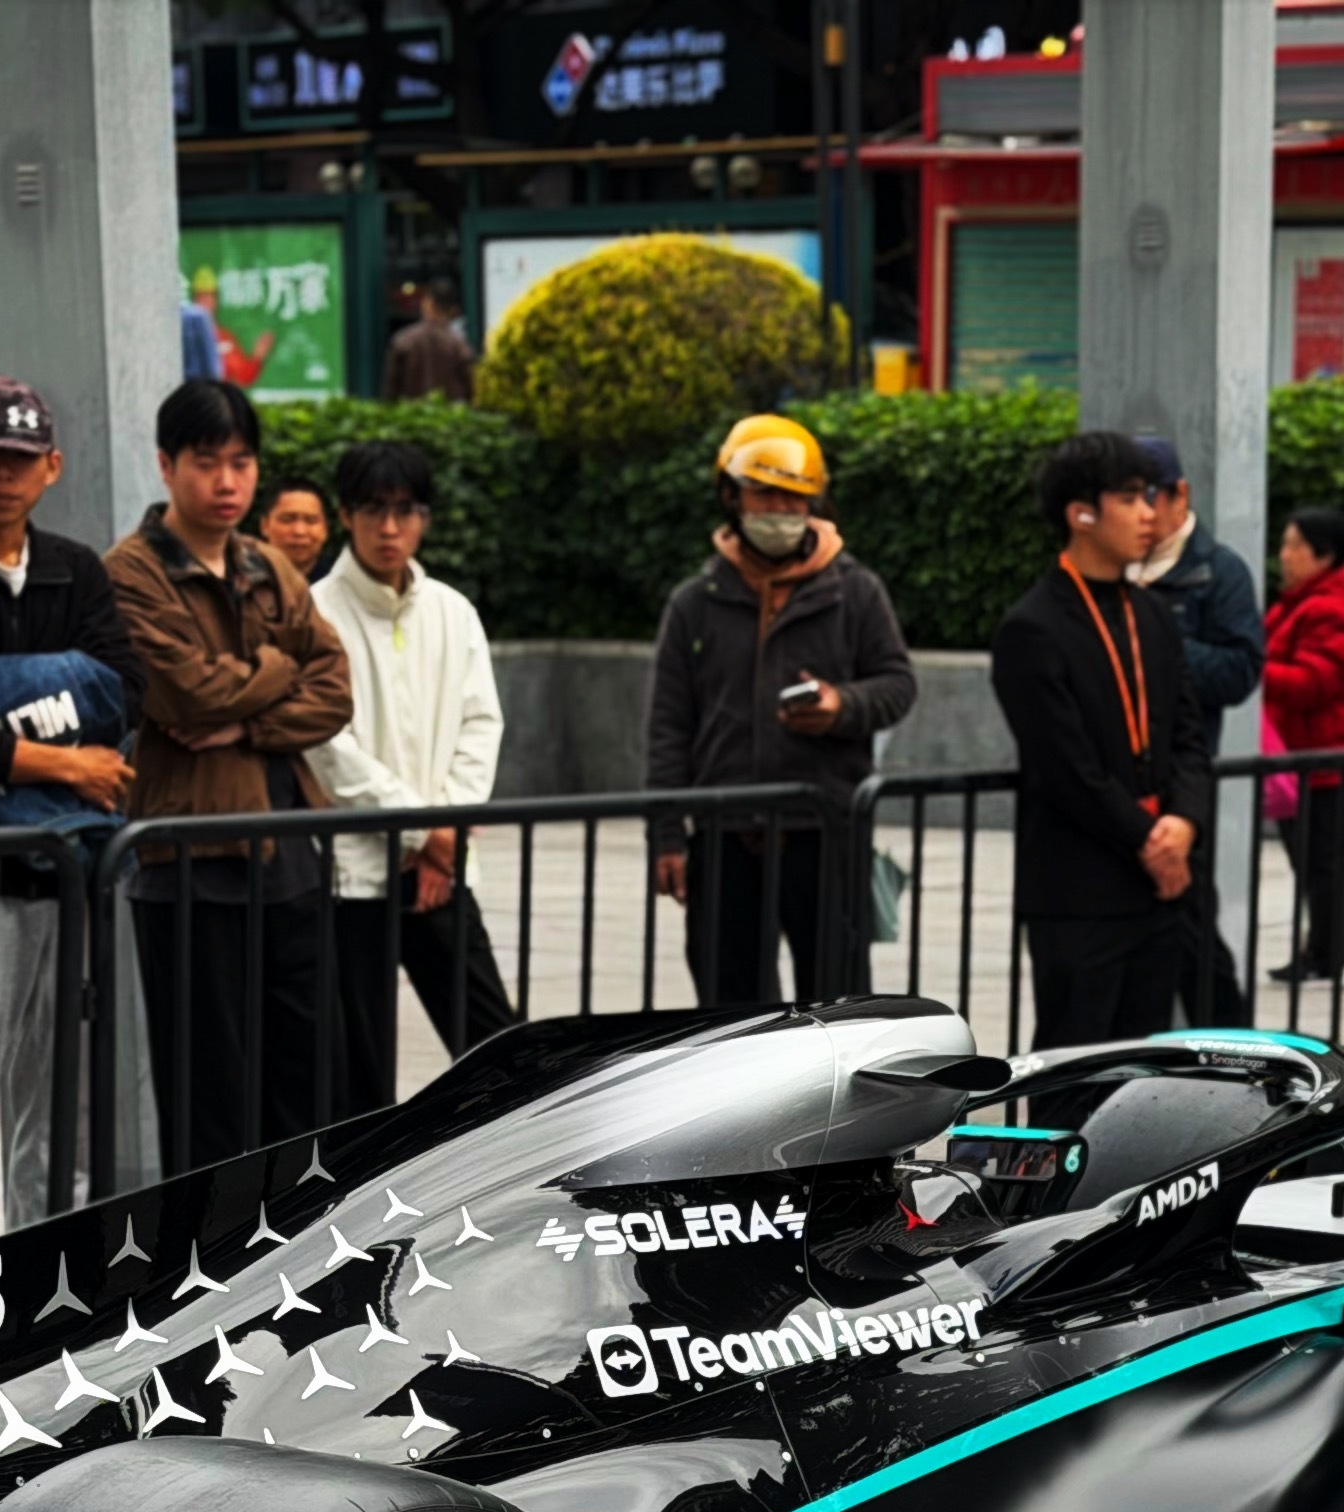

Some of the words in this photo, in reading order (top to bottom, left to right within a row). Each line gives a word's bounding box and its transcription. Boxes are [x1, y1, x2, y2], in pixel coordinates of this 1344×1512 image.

[1211, 1053, 1267, 1069] Snapdragon
[1136, 1169, 1206, 1227] AMD
[584, 1200, 780, 1256] SOLERA
[651, 1297, 984, 1382] TeamViewer
